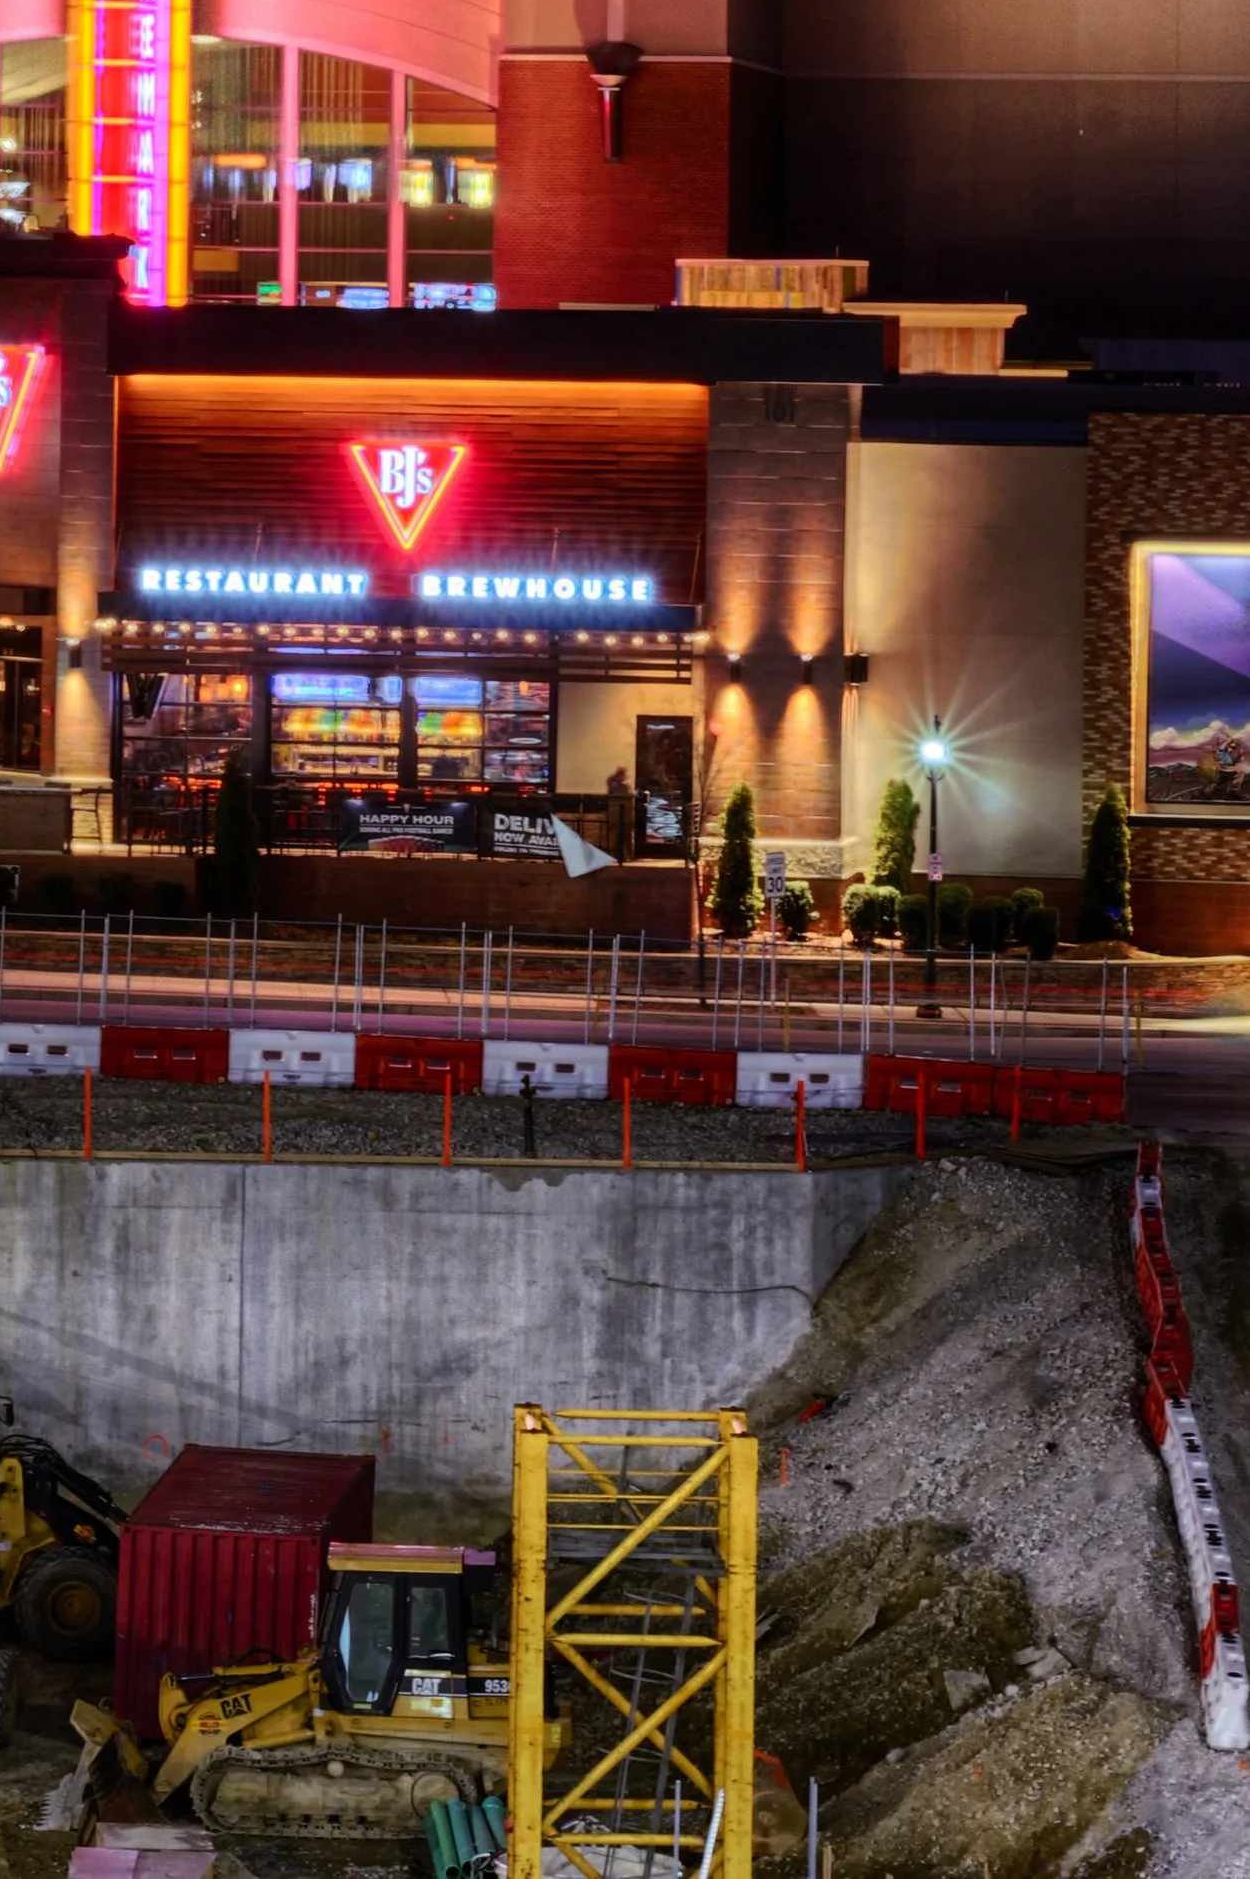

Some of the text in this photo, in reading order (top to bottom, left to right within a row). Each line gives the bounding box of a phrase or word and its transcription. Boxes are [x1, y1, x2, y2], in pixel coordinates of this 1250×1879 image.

[141, 568, 650, 601] RESTAURANT BREWHOUSE
[359, 814, 454, 825] HAPPY HOUR
[494, 832, 524, 843] NOW
[768, 876, 783, 892] 30
[412, 1678, 510, 1695] CAT 953
[220, 1693, 252, 1719] CAT
